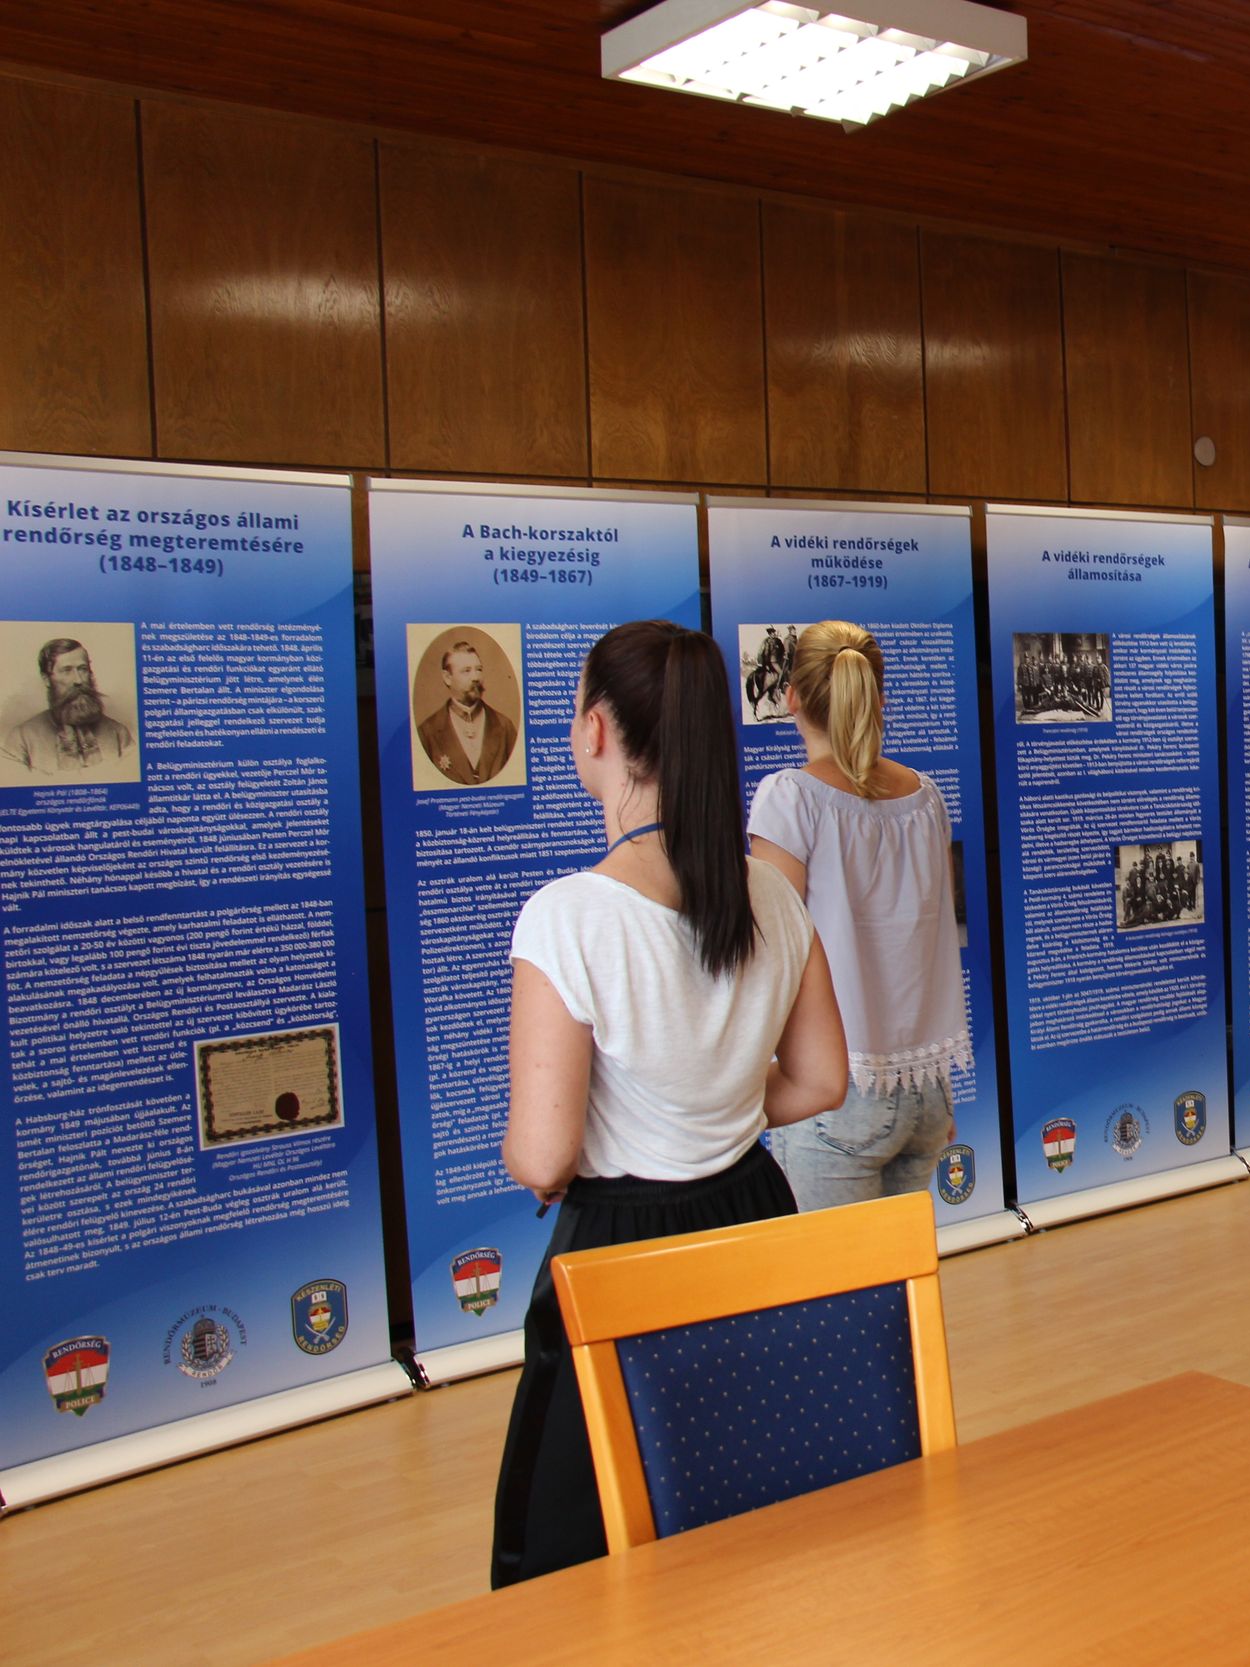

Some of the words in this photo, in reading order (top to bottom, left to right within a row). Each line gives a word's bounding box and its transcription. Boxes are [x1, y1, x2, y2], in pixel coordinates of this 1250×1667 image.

[8, 500, 99, 521] Kísérlet
[106, 509, 130, 522] az
[137, 508, 230, 530] országos
[236, 510, 298, 530] állami
[3, 526, 121, 551] rendőrség
[129, 533, 304, 553] megteremtésére
[462, 524, 474, 539] A
[480, 525, 618, 542] Bach-korszaktól
[771, 535, 781, 548] A
[785, 535, 828, 549] vidéki
[833, 536, 919, 555] rendőrségek
[100, 555, 223, 576] (1848–1849)
[484, 550, 494, 561] a
[500, 546, 600, 567] kiegyezésig
[811, 555, 883, 569] működése
[1042, 551, 1051, 562] A
[1054, 551, 1090, 563] vidéki
[1093, 552, 1165, 568] rendőrségek
[494, 569, 593, 587] (1849–1867)
[808, 574, 888, 591] (1867–1919)
[1068, 568, 1142, 582] államosítása
[146, 740, 176, 748] rendőri
[176, 739, 224, 748] feladatokat.
[25, 1109, 85, 1124] Habsburg-ház
[88, 1100, 143, 1114] trónfosztását
[145, 1095, 183, 1106] követően
[16, 1125, 55, 1136] kormány
[60, 1120, 81, 1129] 1849
[84, 1114, 130, 1127] májusában
[134, 1106, 176, 1120] újjáalakult.
[25, 1270, 46, 1281] csak
[47, 1268, 65, 1277] terv
[66, 1262, 99, 1273] maradt.
